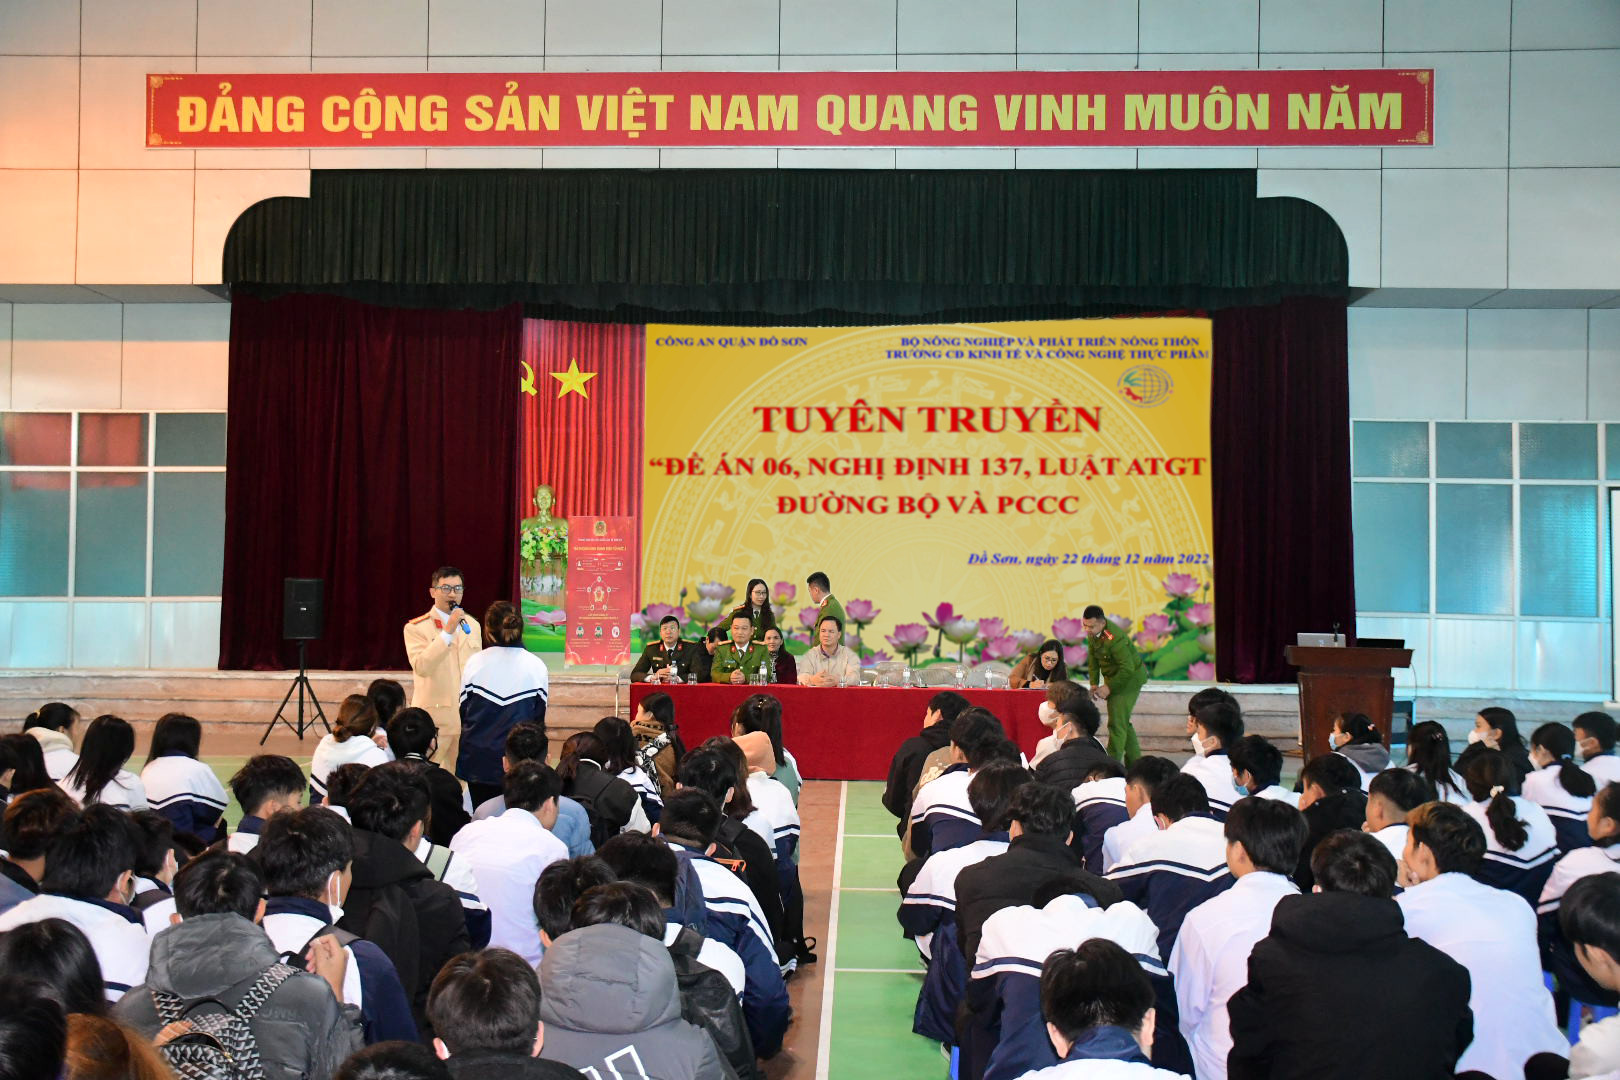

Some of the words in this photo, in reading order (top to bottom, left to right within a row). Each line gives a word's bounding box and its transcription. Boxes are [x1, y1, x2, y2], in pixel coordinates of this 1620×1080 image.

[177, 82, 305, 133] ĐẢNG
[321, 88, 448, 139] CỘNG
[464, 81, 561, 132] SẢN
[575, 87, 675, 138] VIỆT
[689, 94, 799, 132] NAM
[816, 94, 978, 135] QUANG
[994, 94, 1106, 131] VINH
[1124, 85, 1269, 131] MUÔN
[1287, 85, 1402, 131] NĂM
[655, 335, 694, 347] CÔNG
[697, 337, 715, 347] AN
[901, 336, 920, 348] BỘ
[923, 335, 961, 347] NÔNG
[1120, 335, 1159, 347] NÔNG
[1162, 335, 1200, 347] THÔN
[968, 349, 1002, 360] KINH
[1025, 348, 1044, 360] VÀ
[1046, 347, 1085, 360] CÔNG
[752, 398, 905, 433] TUYÊN
[917, 398, 1102, 433] TRUYỀN
[713, 452, 753, 476] ÁN
[762, 457, 800, 479] 06,
[808, 457, 884, 481] NGHỊ
[894, 457, 969, 480] ĐỊNH
[981, 457, 1031, 479] 137,
[1039, 455, 1120, 481] LUẬT
[1125, 457, 1207, 476] ATGT
[776, 491, 888, 515] ĐƯỜNG
[898, 493, 940, 519] BỘ
[947, 491, 988, 514] VÀ
[997, 496, 1079, 514] PCCC
[1062, 553, 1079, 565] 22
[1081, 552, 1121, 566] tháng
[1125, 553, 1141, 565] 12
[1177, 553, 1211, 565] 2022
